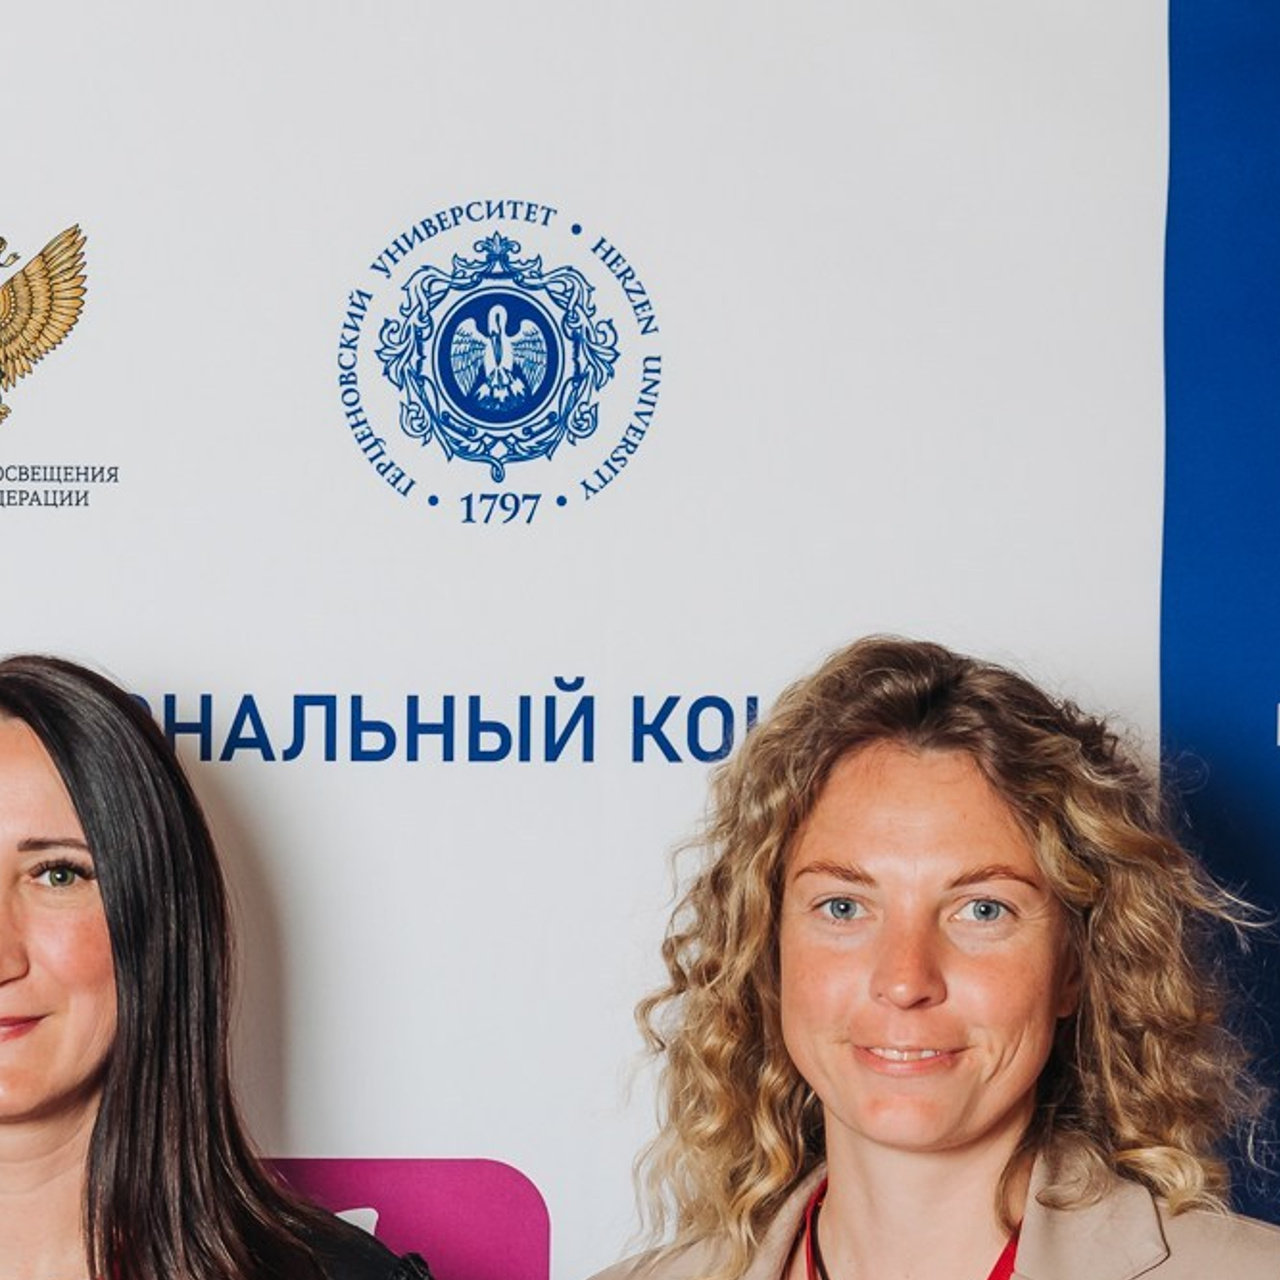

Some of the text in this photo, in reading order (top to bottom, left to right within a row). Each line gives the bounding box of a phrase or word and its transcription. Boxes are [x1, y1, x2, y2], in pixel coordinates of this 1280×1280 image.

[370, 200, 557, 279] УНИВЕРСИТЕТ
[590, 237, 659, 336] HERZEN
[337, 288, 417, 497] ГЕРЦЕНОВСКИЙ
[579, 355, 662, 501] UNIVERSITY
[460, 493, 542, 524] 1797
